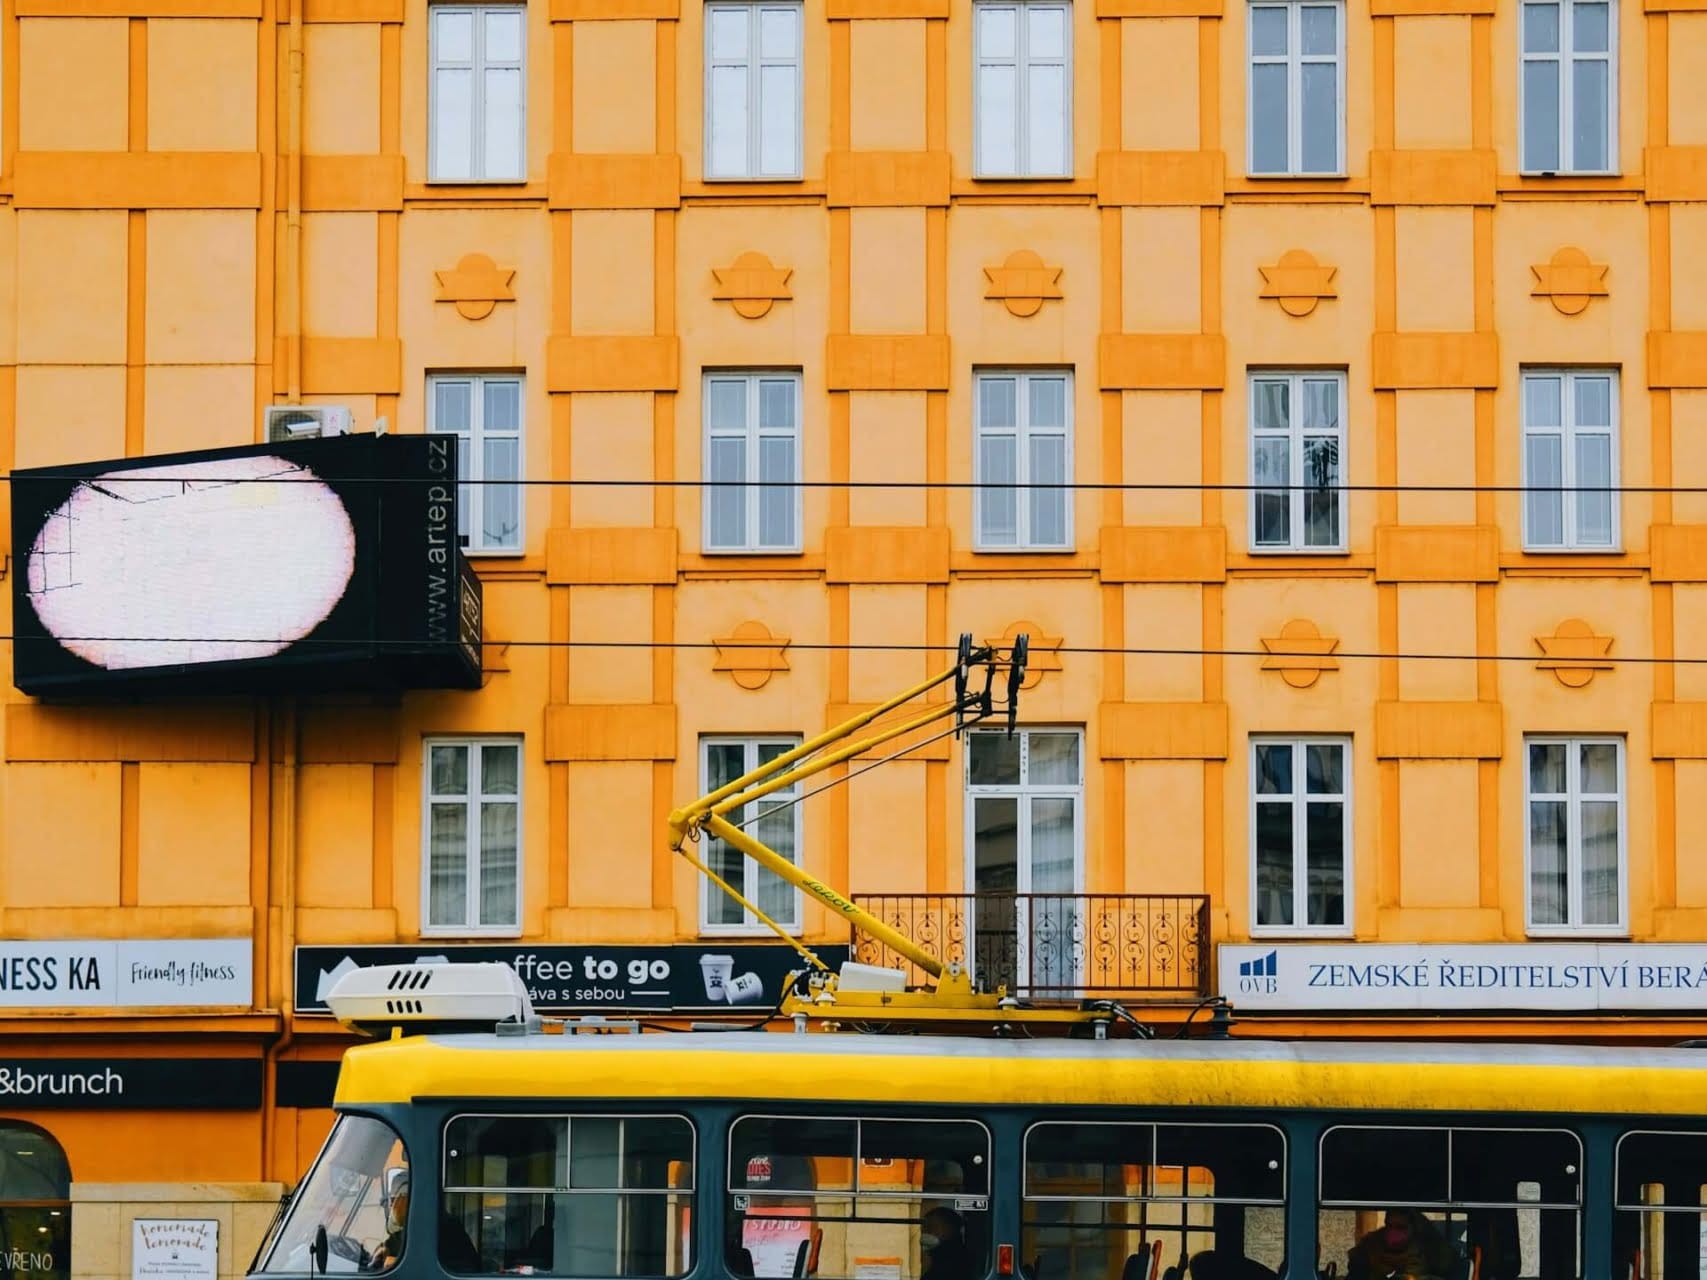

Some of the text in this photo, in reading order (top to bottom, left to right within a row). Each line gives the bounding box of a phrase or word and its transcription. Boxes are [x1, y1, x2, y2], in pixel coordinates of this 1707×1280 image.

[69, 957, 101, 990] KA
[132, 961, 235, 986] Friendly fitness
[511, 954, 671, 985] ffee to go
[1308, 958, 1430, 988] ZEMSKÉ
[1438, 959, 1628, 988] ŘEDITELSTVÍ
[528, 986, 625, 1001] áva s sebou
[1240, 977, 1277, 994] OVB
[0, 1067, 123, 1094] &brunch
[0, 1248, 53, 1272] VŘENO
